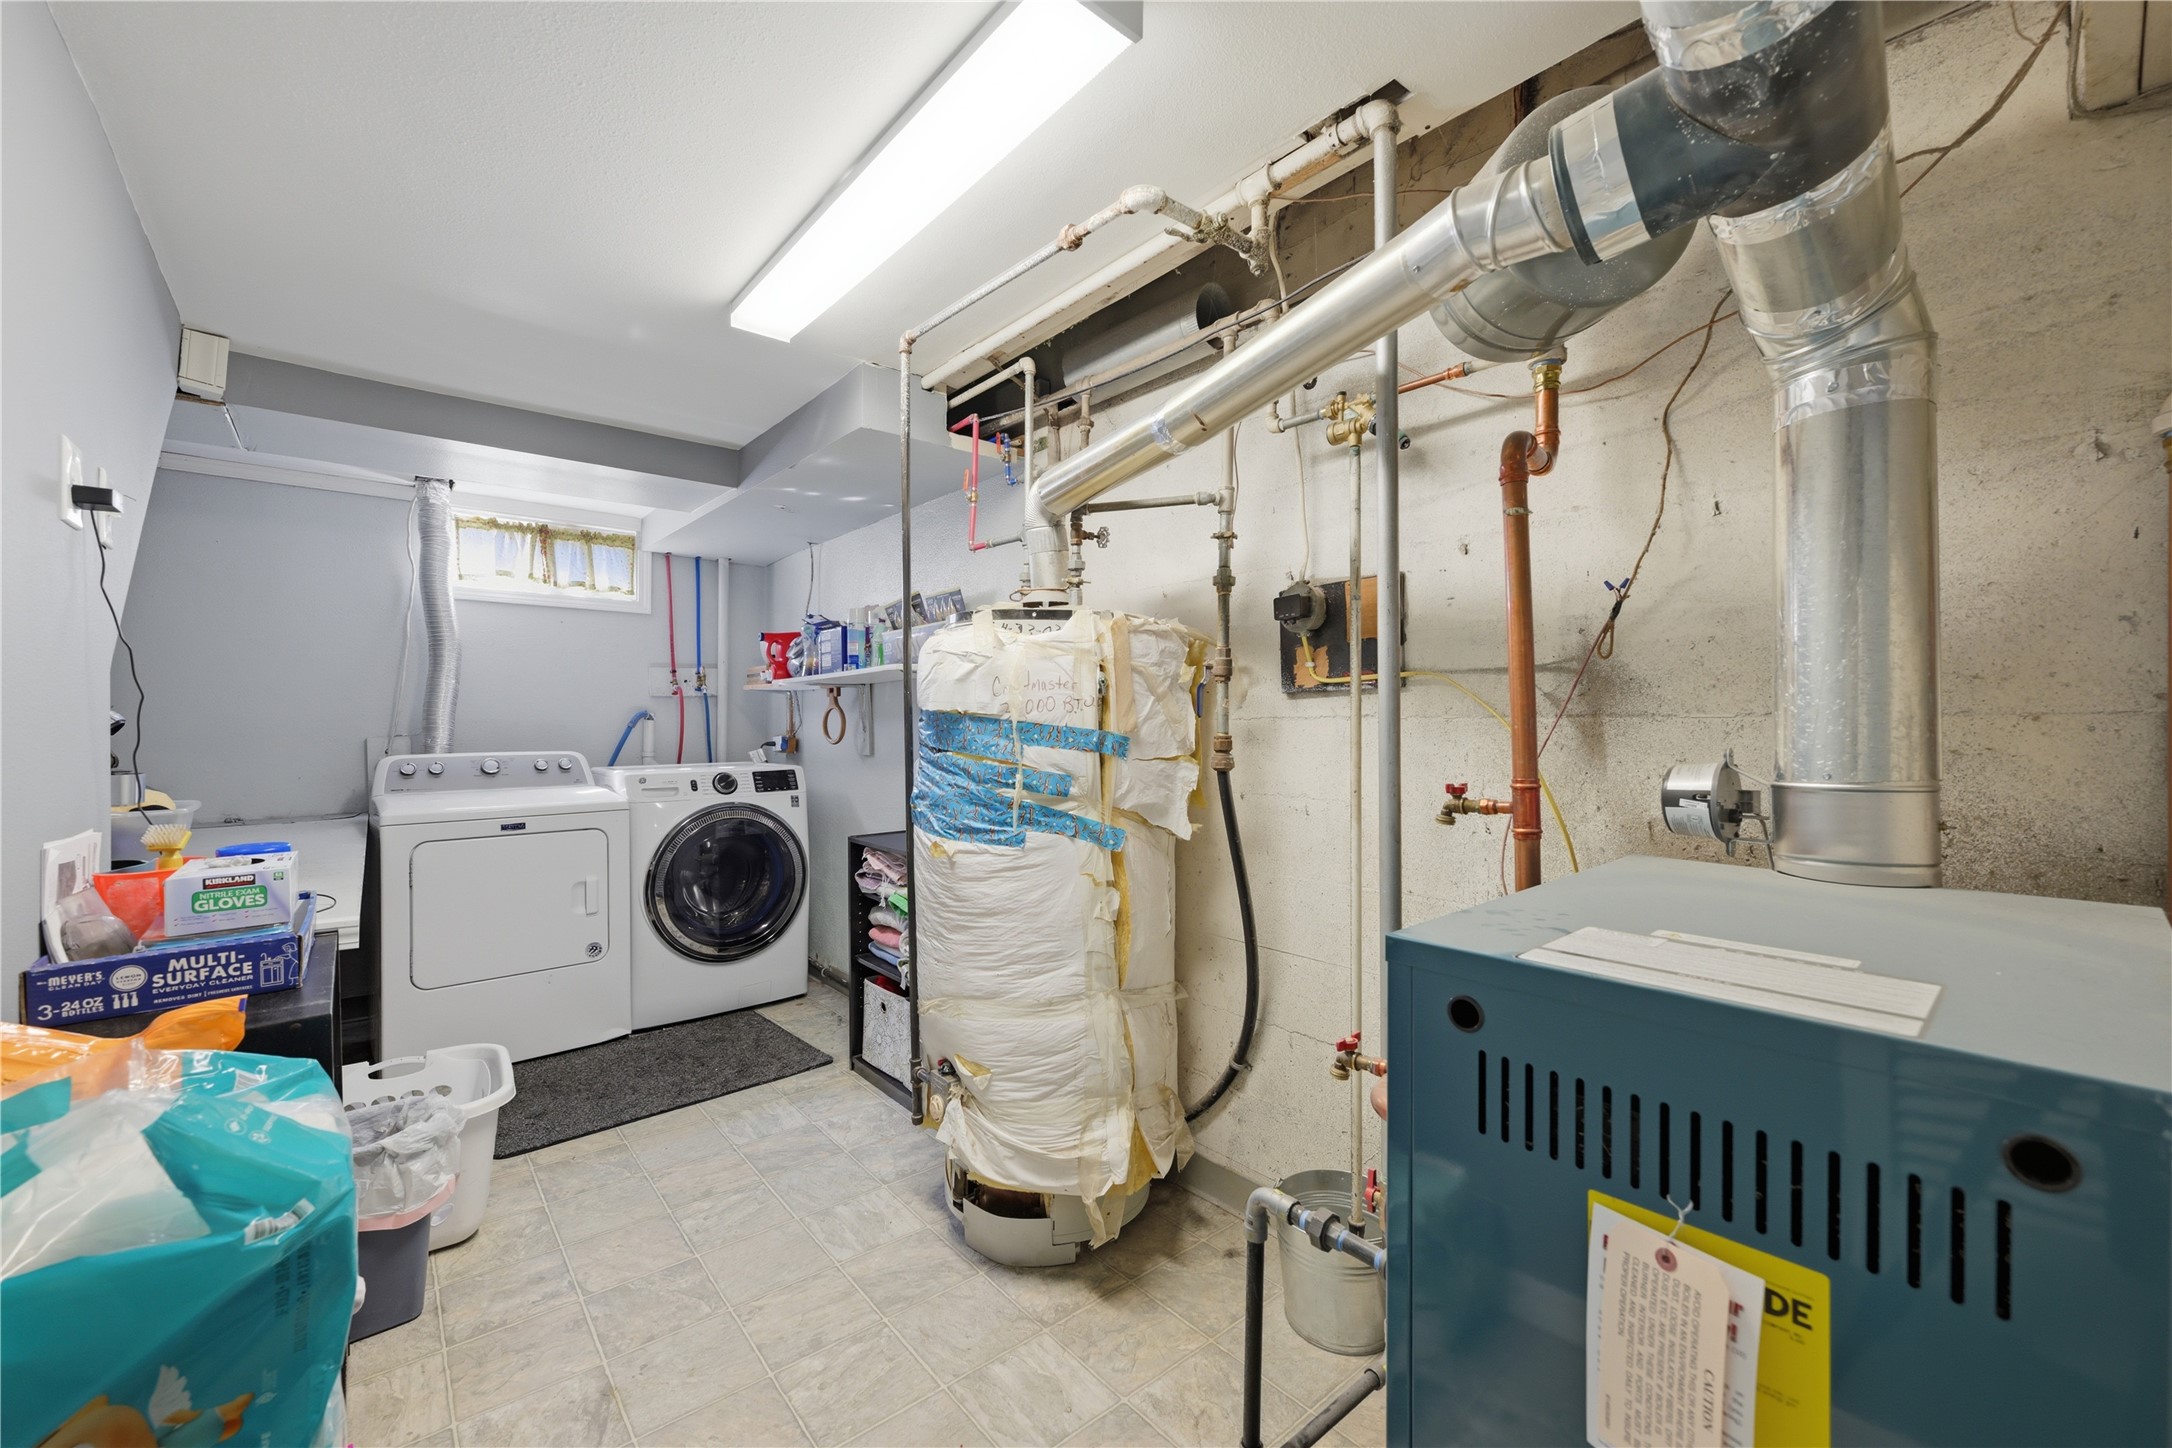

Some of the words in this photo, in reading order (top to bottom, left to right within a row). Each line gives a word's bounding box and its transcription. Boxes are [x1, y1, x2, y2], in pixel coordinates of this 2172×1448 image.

[204, 874, 255, 886] KIRKLAND
[194, 893, 266, 912] GLOVES
[199, 888, 233, 900] NITRILE
[235, 887, 260, 897] EXAM
[167, 951, 245, 972] MULTI-
[152, 962, 253, 988] SURFACE
[152, 981, 206, 995] EVERYDAY
[208, 974, 254, 986] CLEANER
[61, 1005, 104, 1018] BOTTLES
[82, 996, 104, 1008] OZ
[1703, 1369, 1715, 1433] CAUTION
